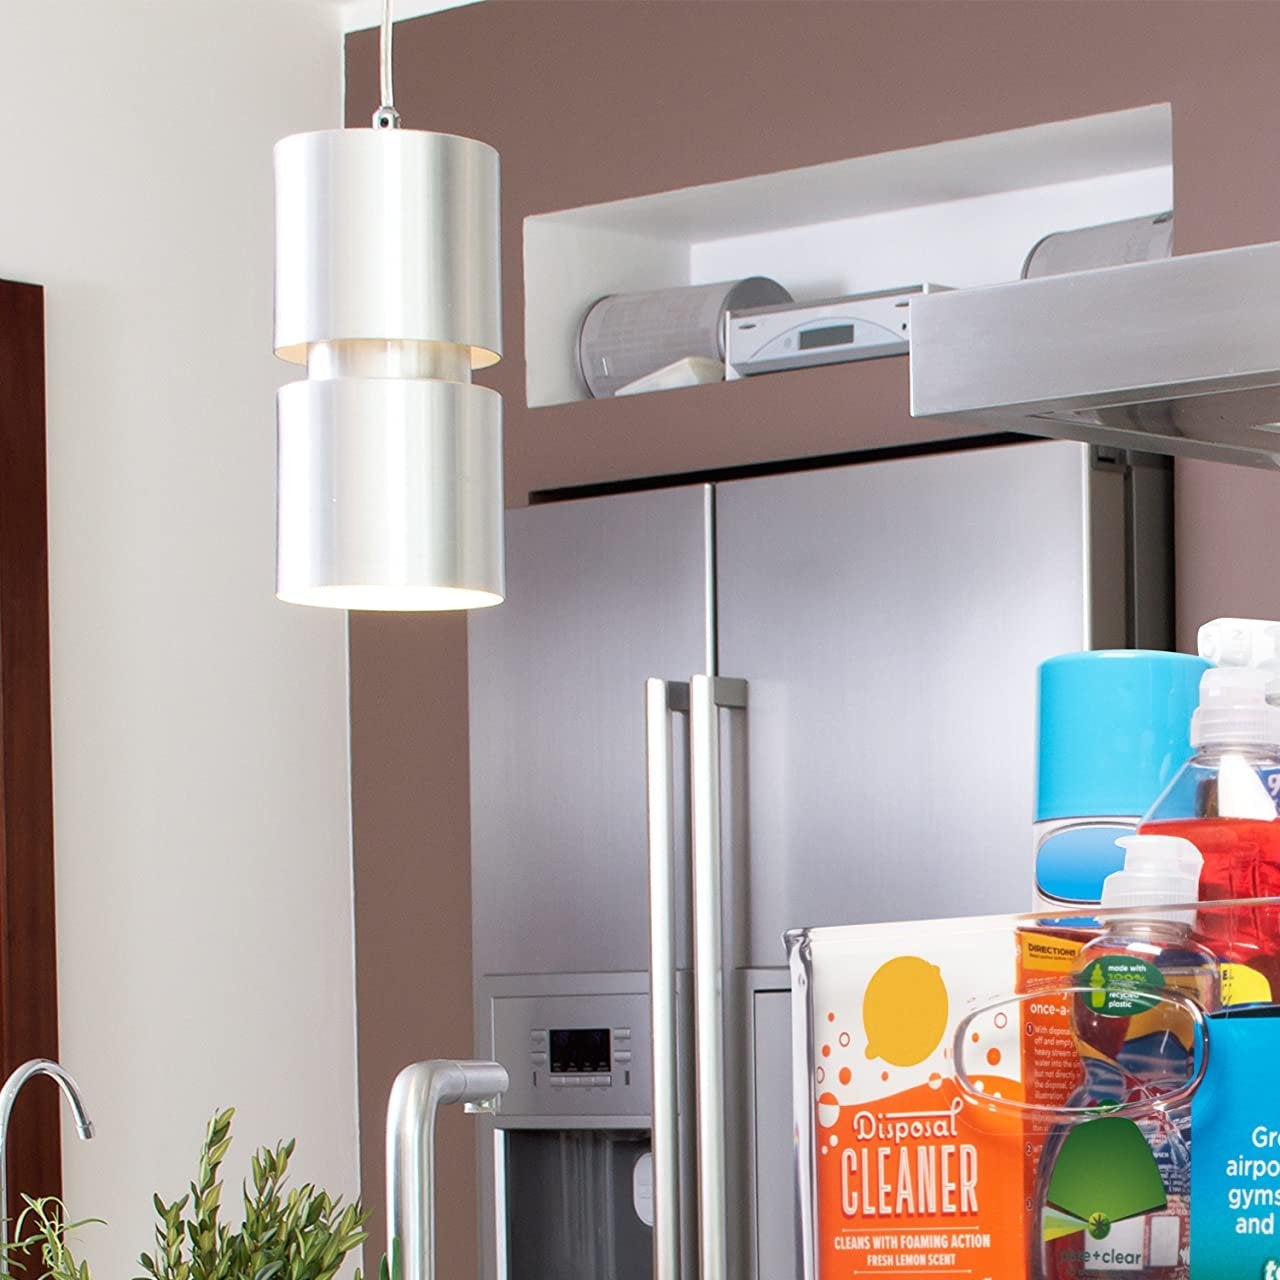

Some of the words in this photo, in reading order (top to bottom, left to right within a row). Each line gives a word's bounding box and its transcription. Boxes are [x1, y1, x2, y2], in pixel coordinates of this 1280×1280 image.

[1107, 964, 1129, 972] made
[1129, 964, 1147, 972] with
[1108, 999, 1132, 1008] plastic
[853, 1096, 964, 1144] Disposal
[841, 1144, 979, 1217] CLEANER
[1235, 1212, 1274, 1235] and
[834, 1235, 871, 1250] CLEANS
[872, 1235, 898, 1249] WITH
[900, 1234, 949, 1249] FOAMING
[951, 1233, 991, 1248] ACTION
[867, 1254, 894, 1266] FRESH
[895, 1254, 927, 1266] LEMON
[928, 1253, 957, 1265] SCENT
